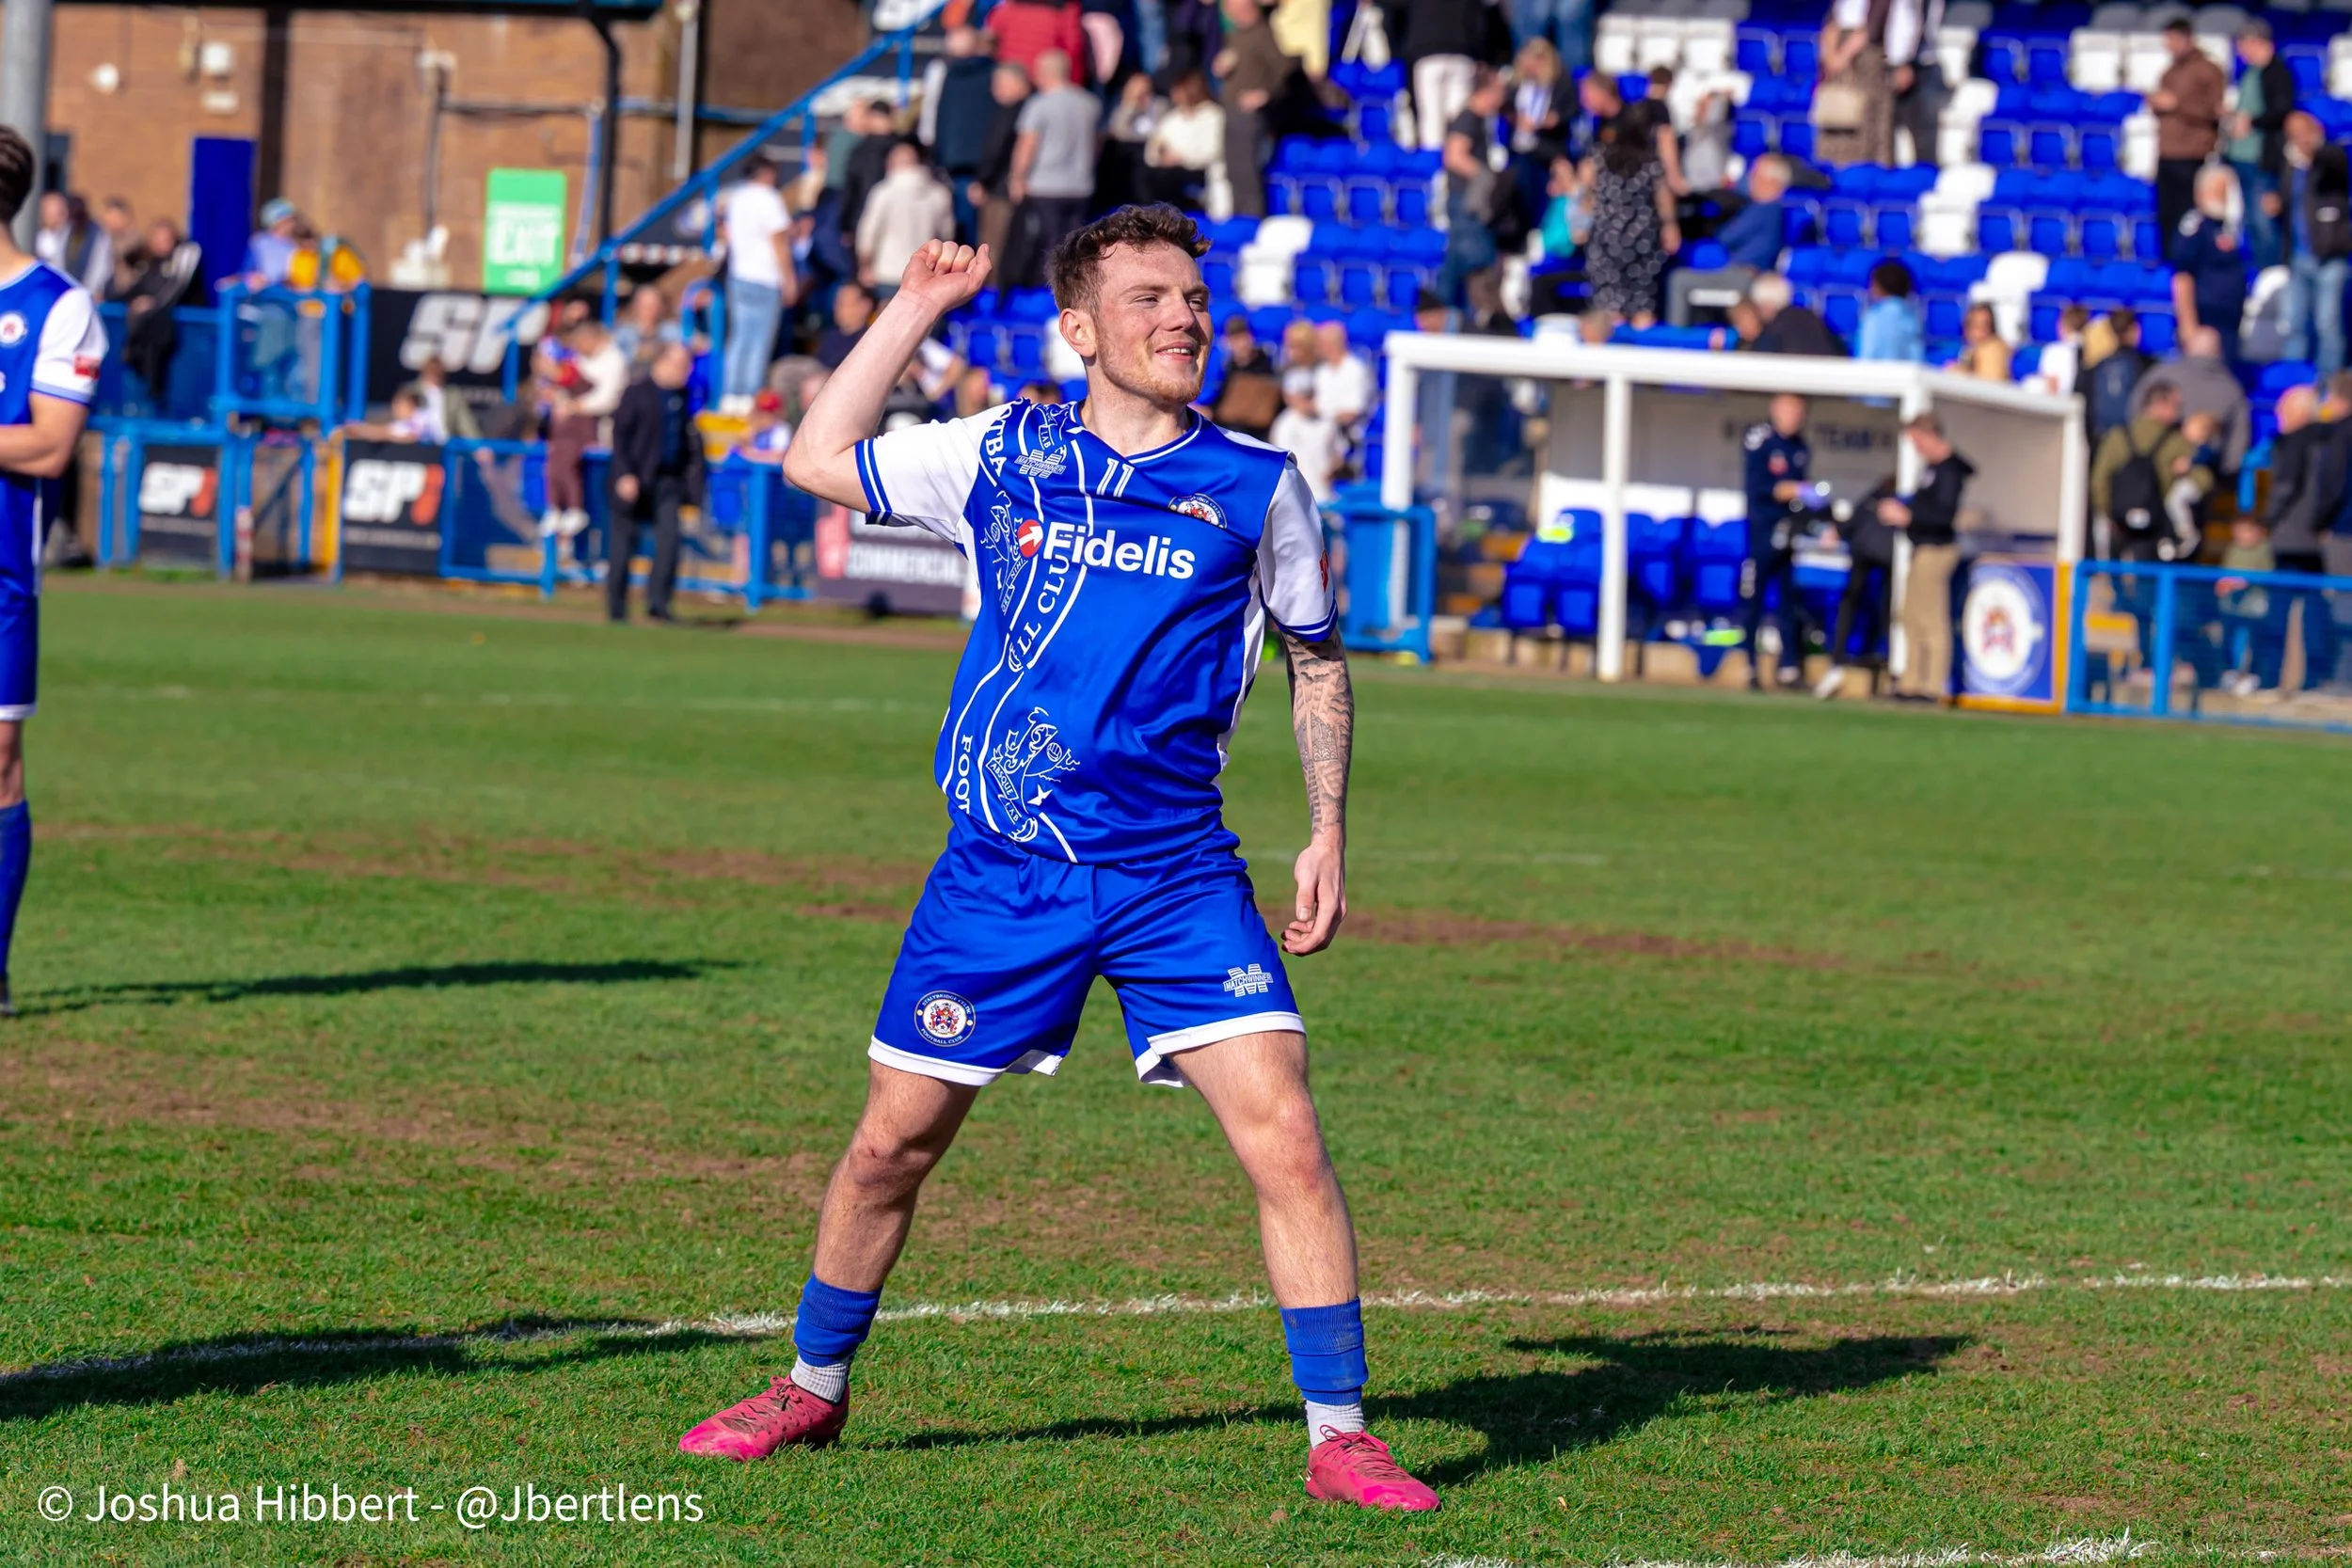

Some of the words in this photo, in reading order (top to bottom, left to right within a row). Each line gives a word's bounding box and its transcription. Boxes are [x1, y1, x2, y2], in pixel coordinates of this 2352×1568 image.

[1096, 457, 1135, 498] 11
[1043, 521, 1196, 579] Fidelis
[990, 763, 1014, 796] ABSQUE
[1005, 801, 1020, 822] LAB
